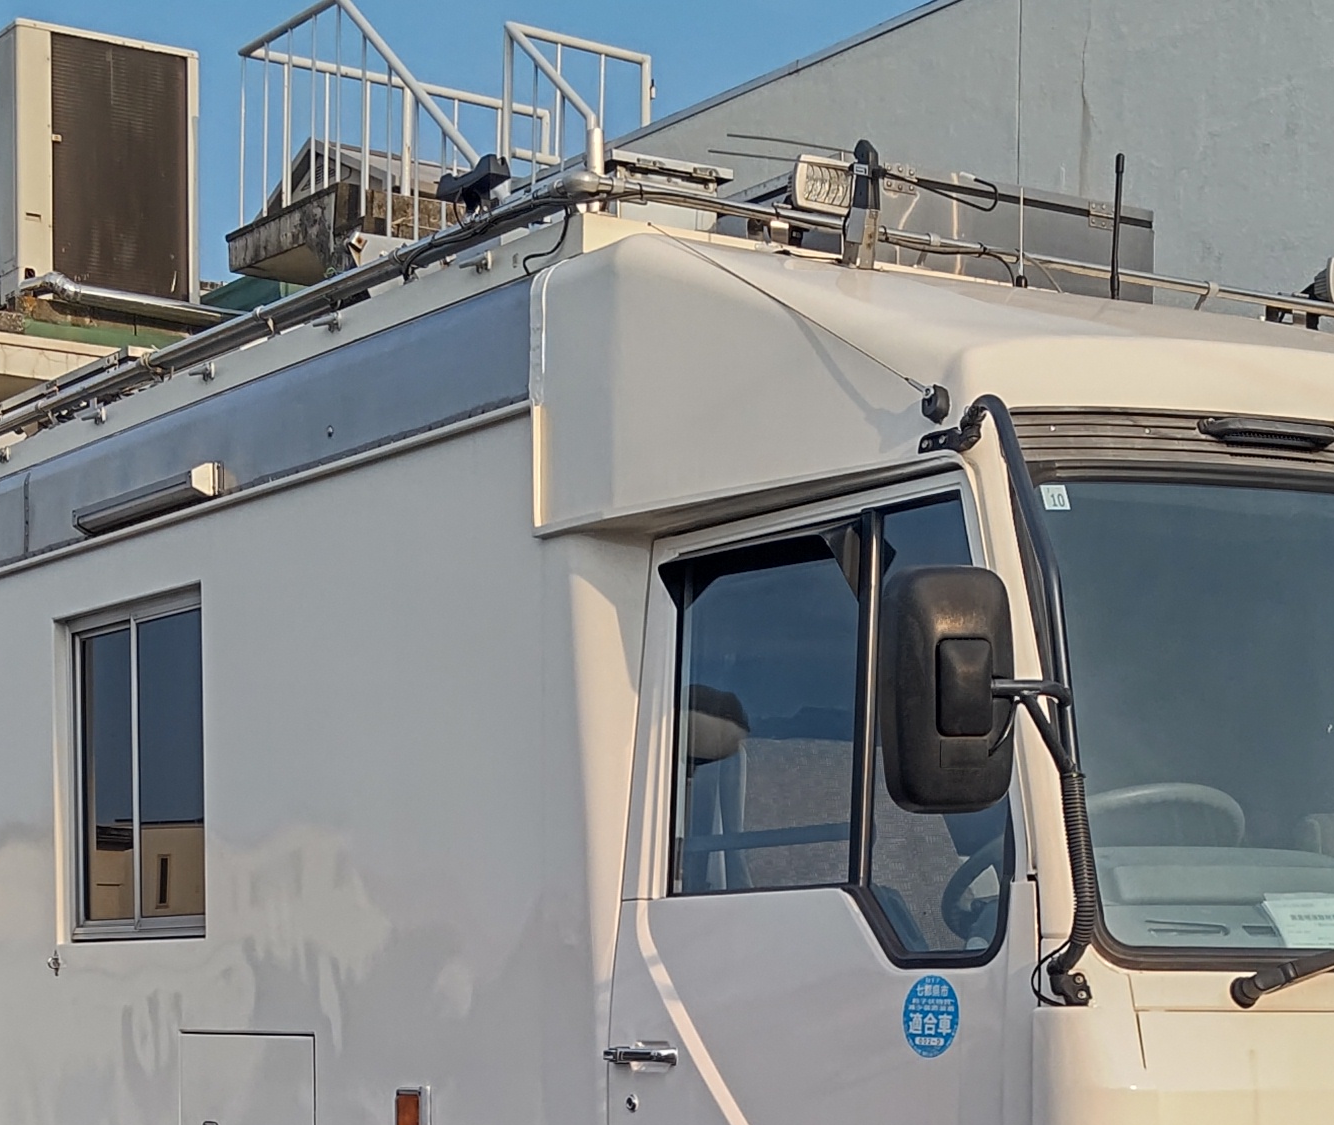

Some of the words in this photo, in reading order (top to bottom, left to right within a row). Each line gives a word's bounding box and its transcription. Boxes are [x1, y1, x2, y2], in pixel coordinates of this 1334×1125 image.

[1050, 493, 1066, 508] 10
[908, 1012, 953, 1037] 適合車
